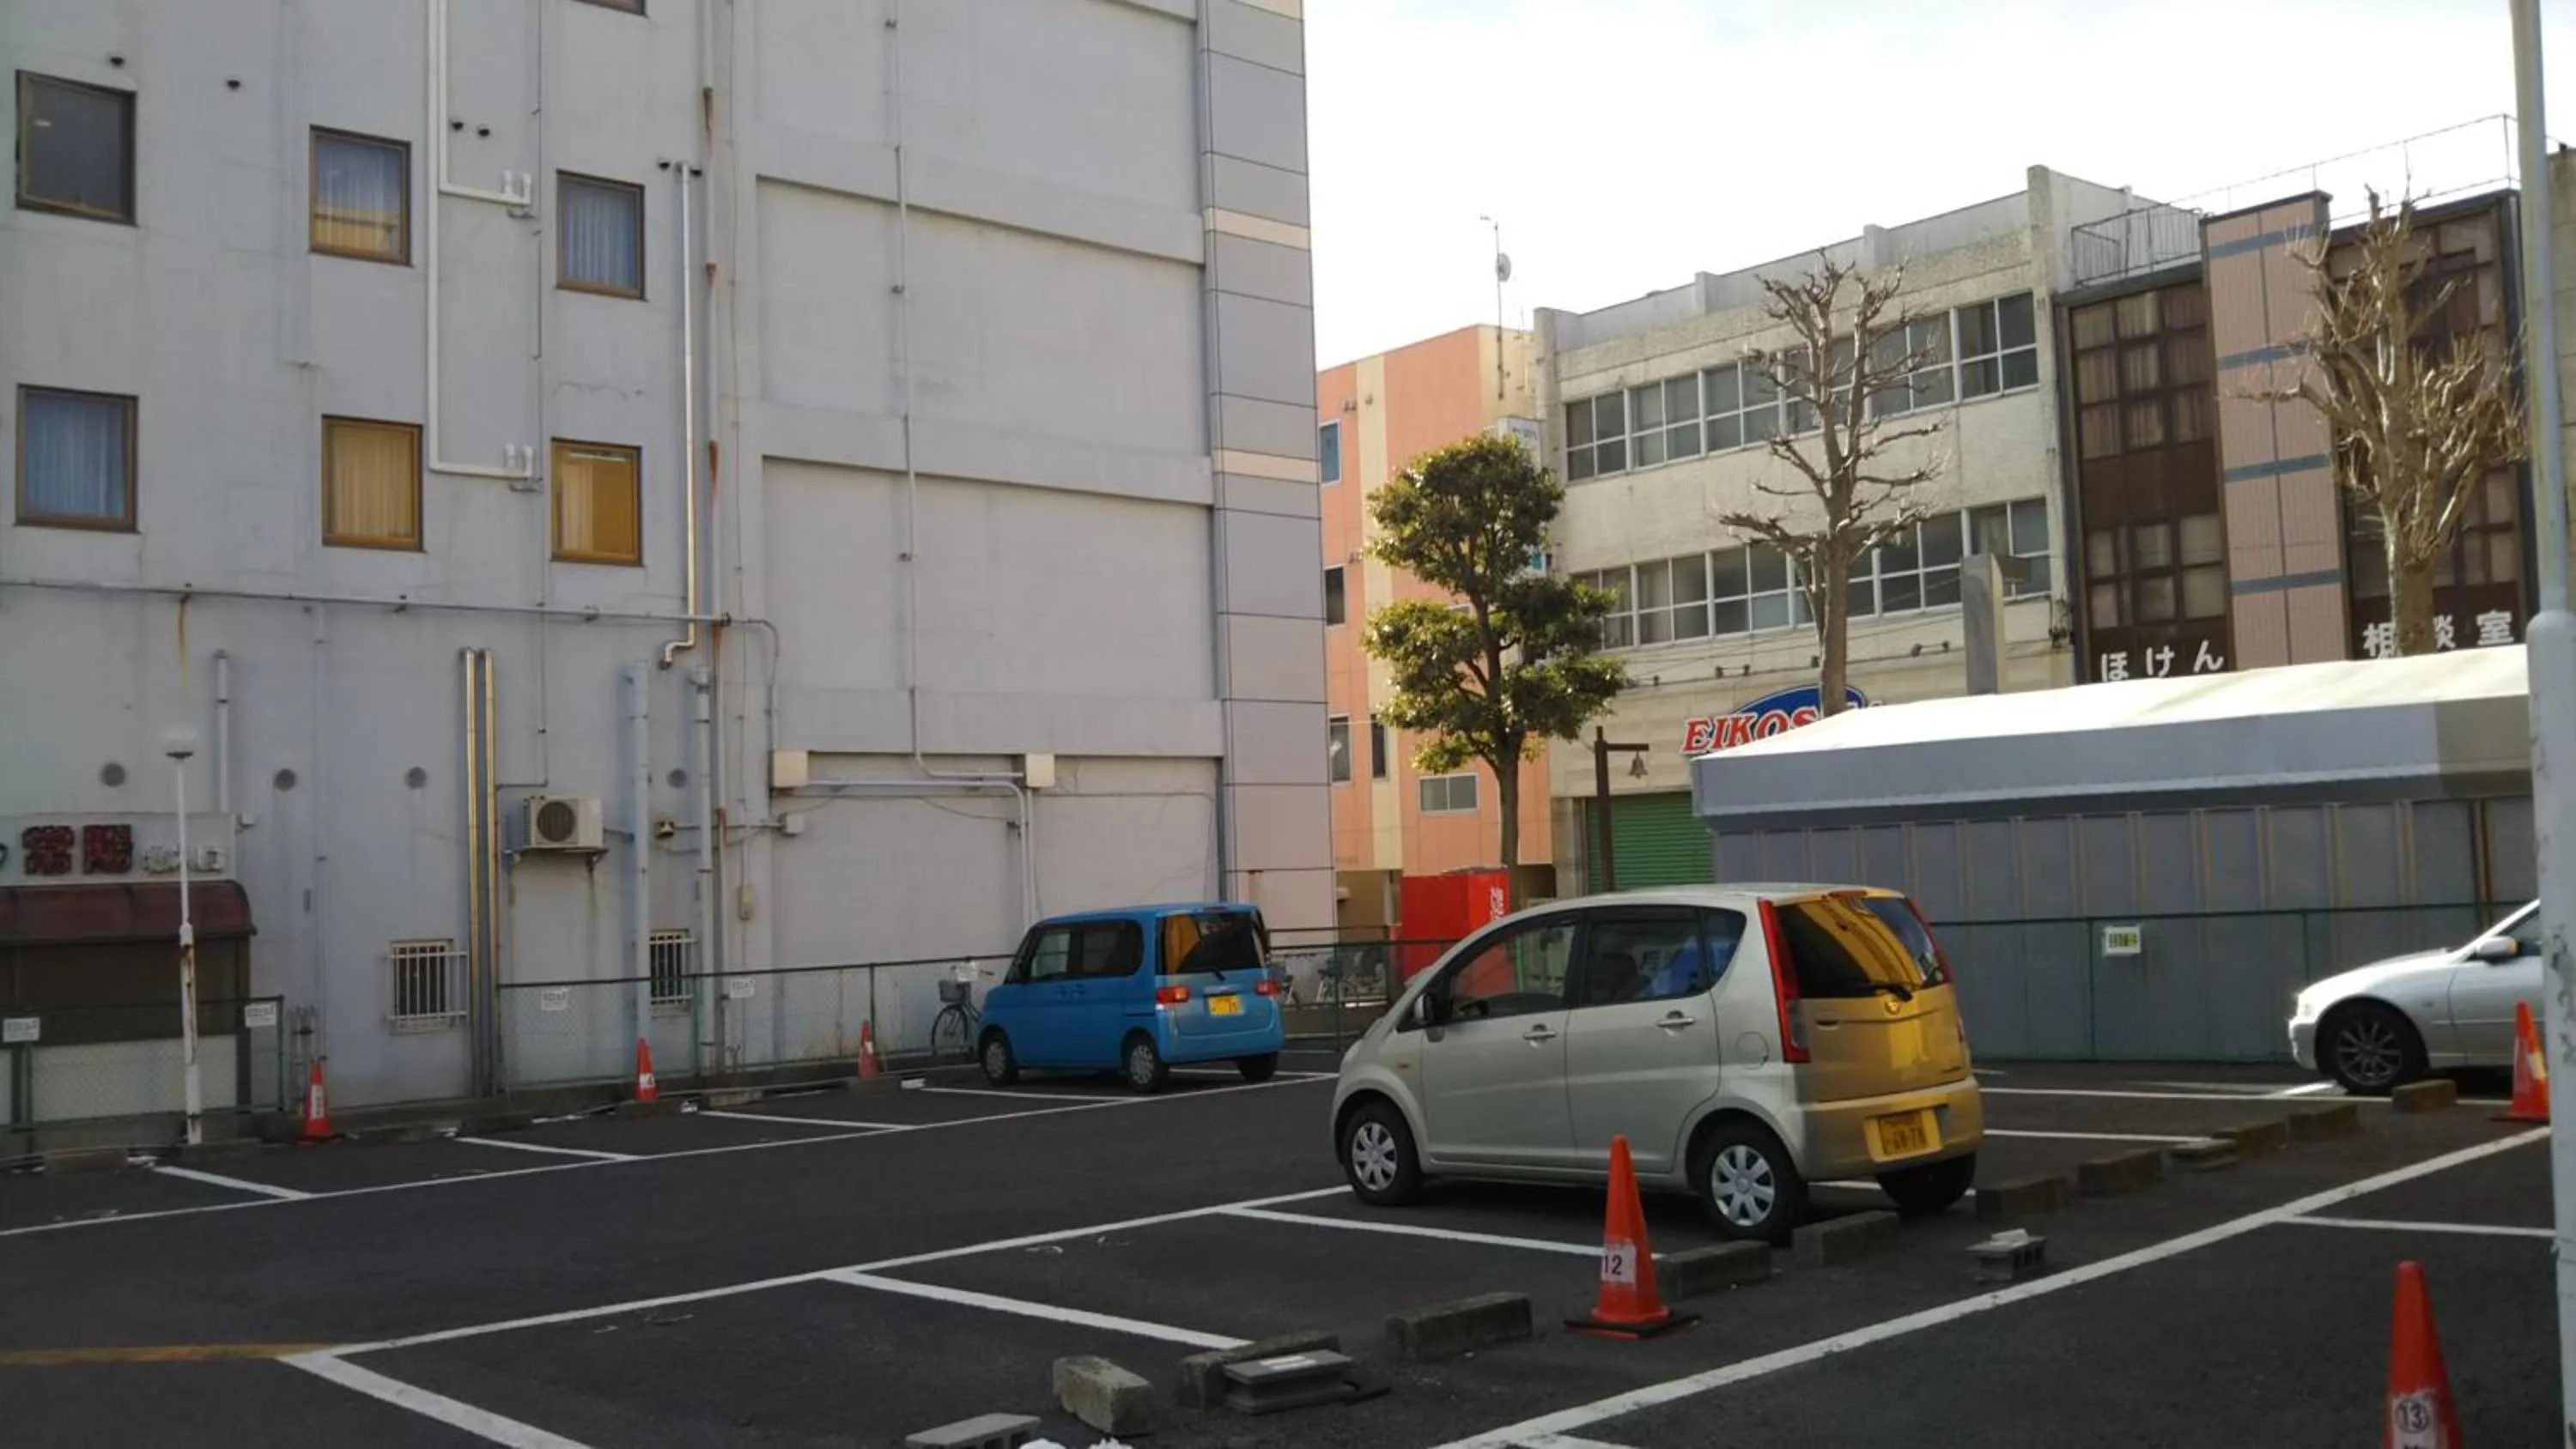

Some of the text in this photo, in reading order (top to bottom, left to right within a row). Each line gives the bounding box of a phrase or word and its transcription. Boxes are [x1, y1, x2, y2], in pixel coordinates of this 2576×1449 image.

[2101, 640, 2224, 682] ほけん
[1605, 1254, 1623, 1276] 12
